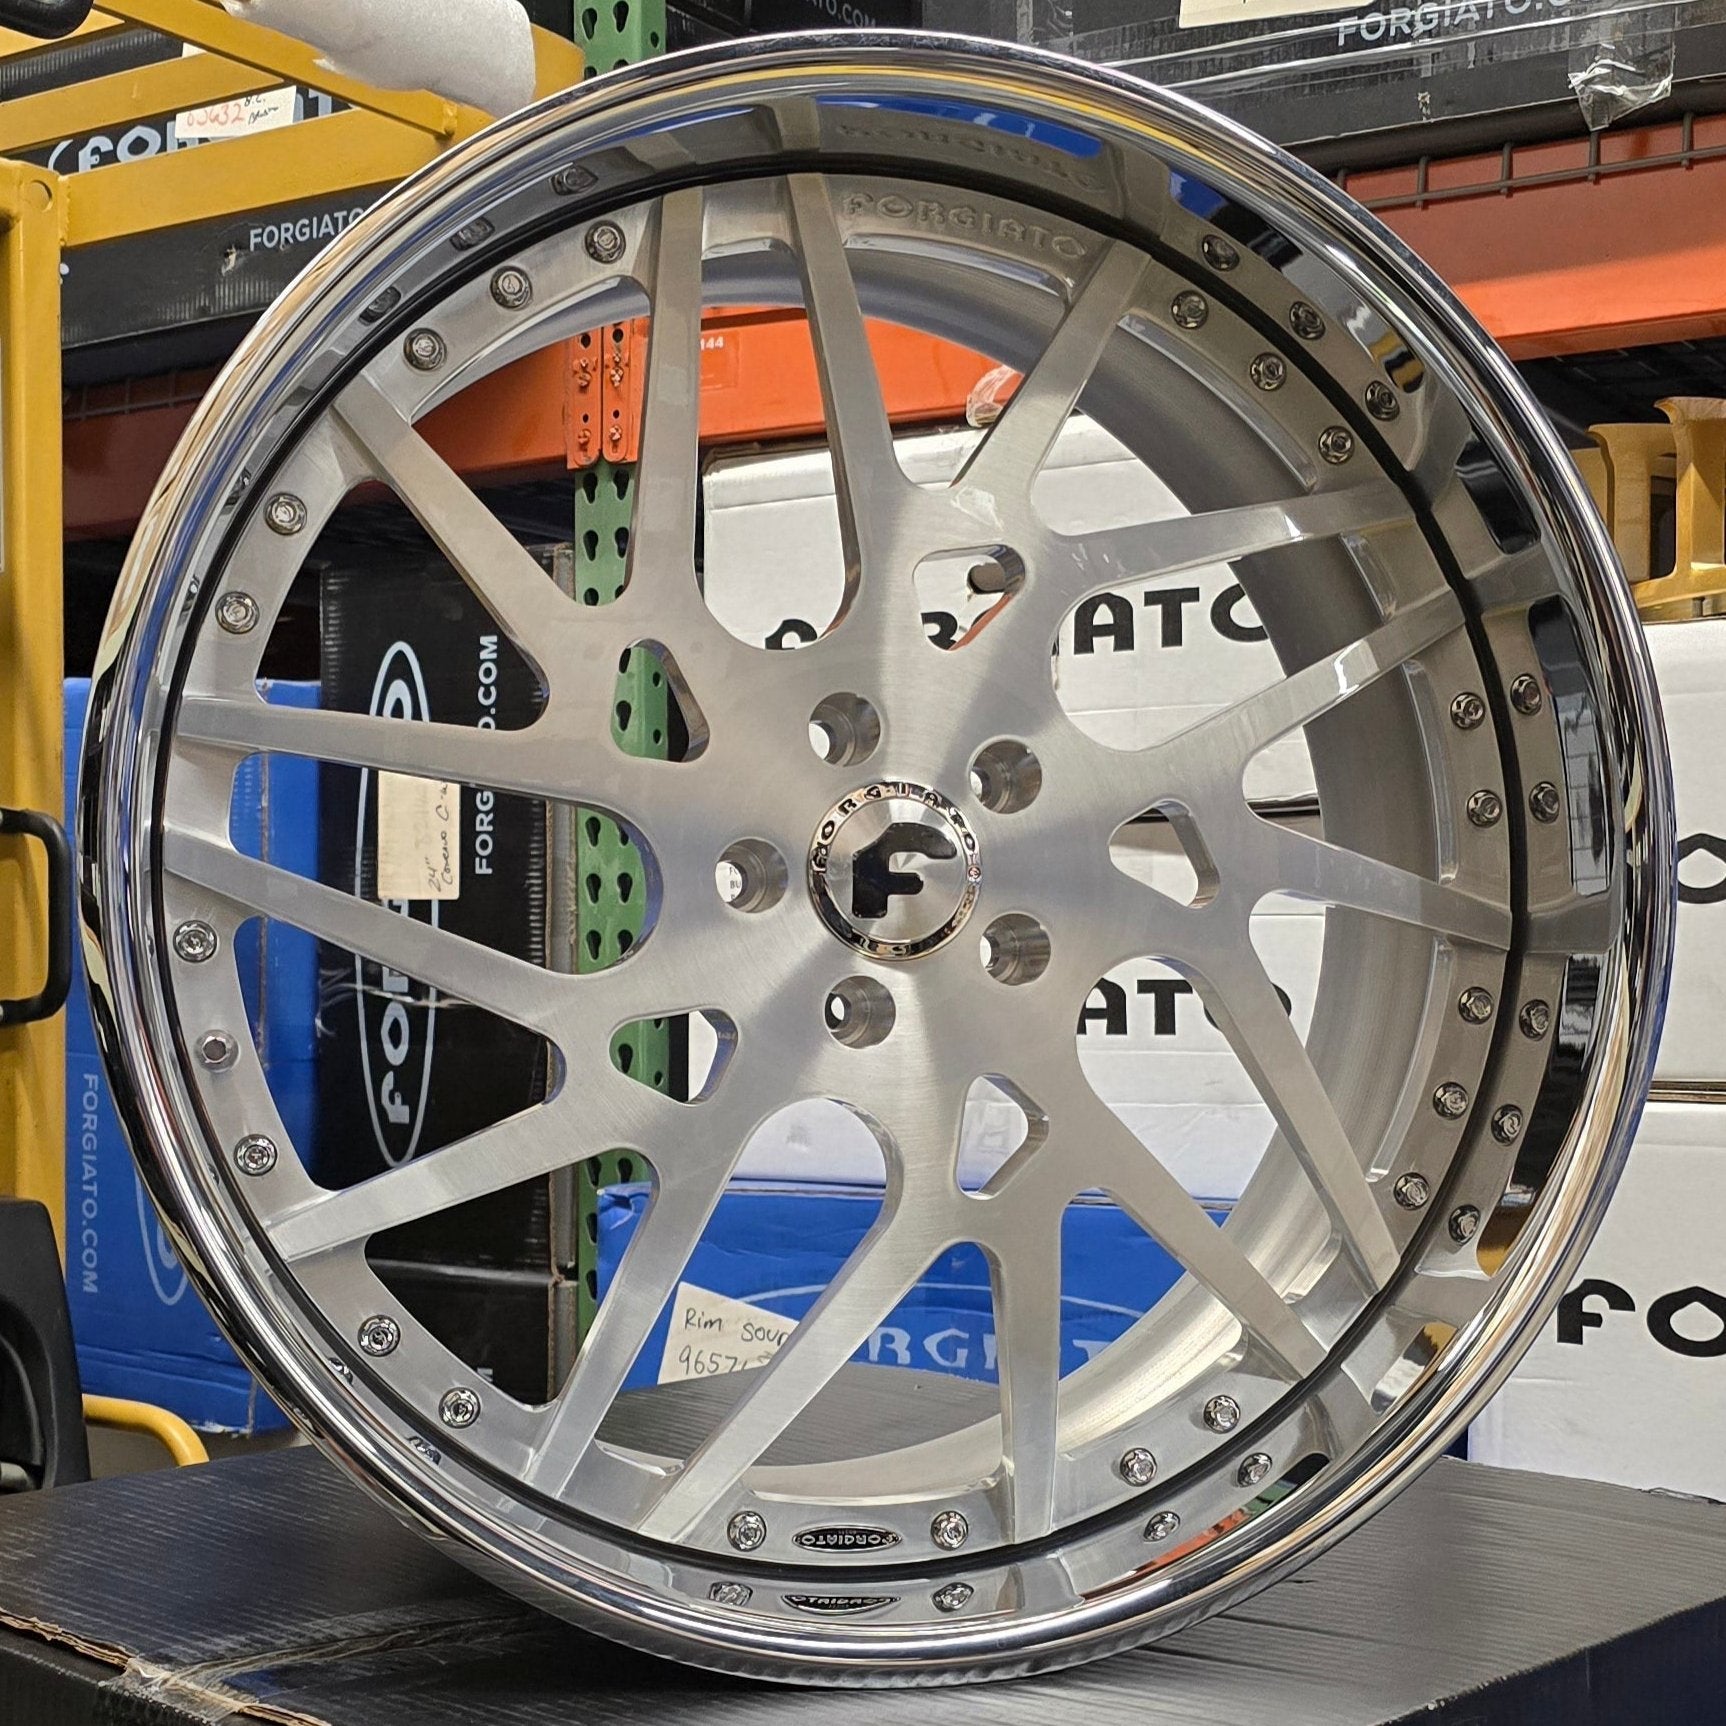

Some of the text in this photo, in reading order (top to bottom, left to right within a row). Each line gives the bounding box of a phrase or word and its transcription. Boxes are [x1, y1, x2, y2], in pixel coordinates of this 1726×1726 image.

[841, 192, 1086, 258] FORGIATO
[82, 1073, 99, 1293] FORGIATO.COM
[685, 1307, 722, 1332] Rim
